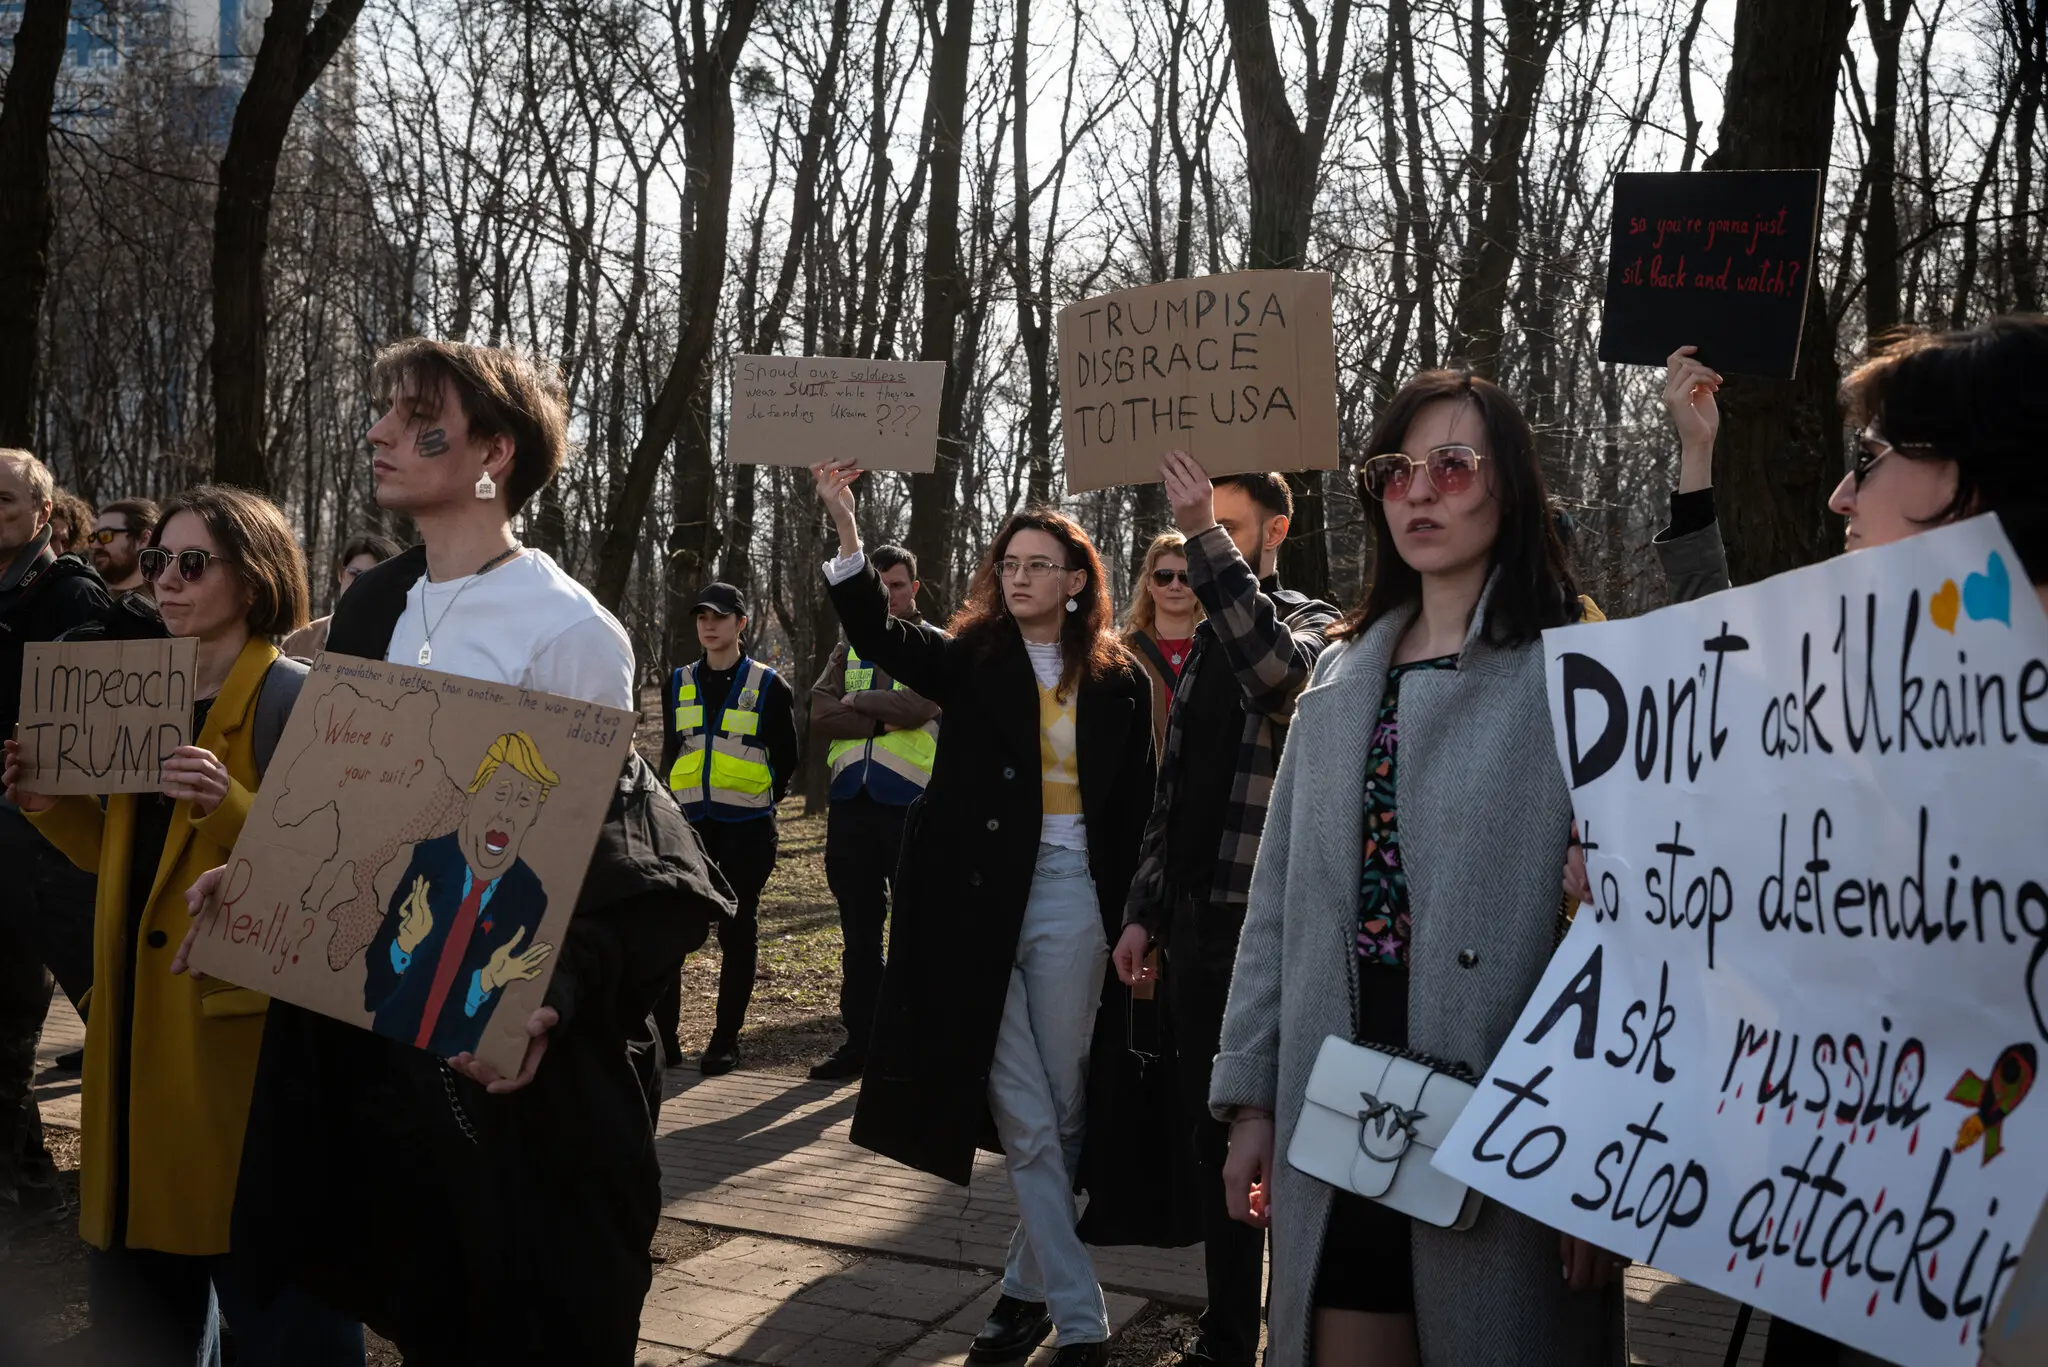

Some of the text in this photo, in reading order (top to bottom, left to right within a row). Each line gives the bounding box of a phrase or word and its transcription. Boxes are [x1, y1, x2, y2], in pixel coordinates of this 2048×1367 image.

[1629, 206, 1788, 256] so you're gonna just
[1621, 255, 1643, 285] sit
[1695, 256, 1732, 290] and
[1737, 258, 1800, 297] watch?
[1078, 333, 1258, 388] DISGRACE
[1210, 385, 1297, 425] USA
[33, 645, 186, 735] impeach
[313, 652, 331, 673] One
[334, 662, 382, 682] grandfather
[387, 672, 395, 685] is
[400, 671, 433, 689] better
[441, 679, 462, 694] than
[517, 690, 539, 710] The
[544, 701, 569, 716] war
[574, 704, 592, 721] of
[595, 708, 621, 727] two
[1555, 621, 1749, 790] Don't
[1762, 632, 1834, 760] ask
[26, 723, 183, 784] TRUMP
[324, 703, 394, 747] Where is
[566, 723, 617, 748] idiots!
[338, 765, 371, 788] your
[1581, 806, 2048, 1044] to stop defending
[1524, 944, 1931, 1131] Ask russia
[1472, 1066, 1567, 1181] to
[1571, 1102, 1709, 1264] stop
